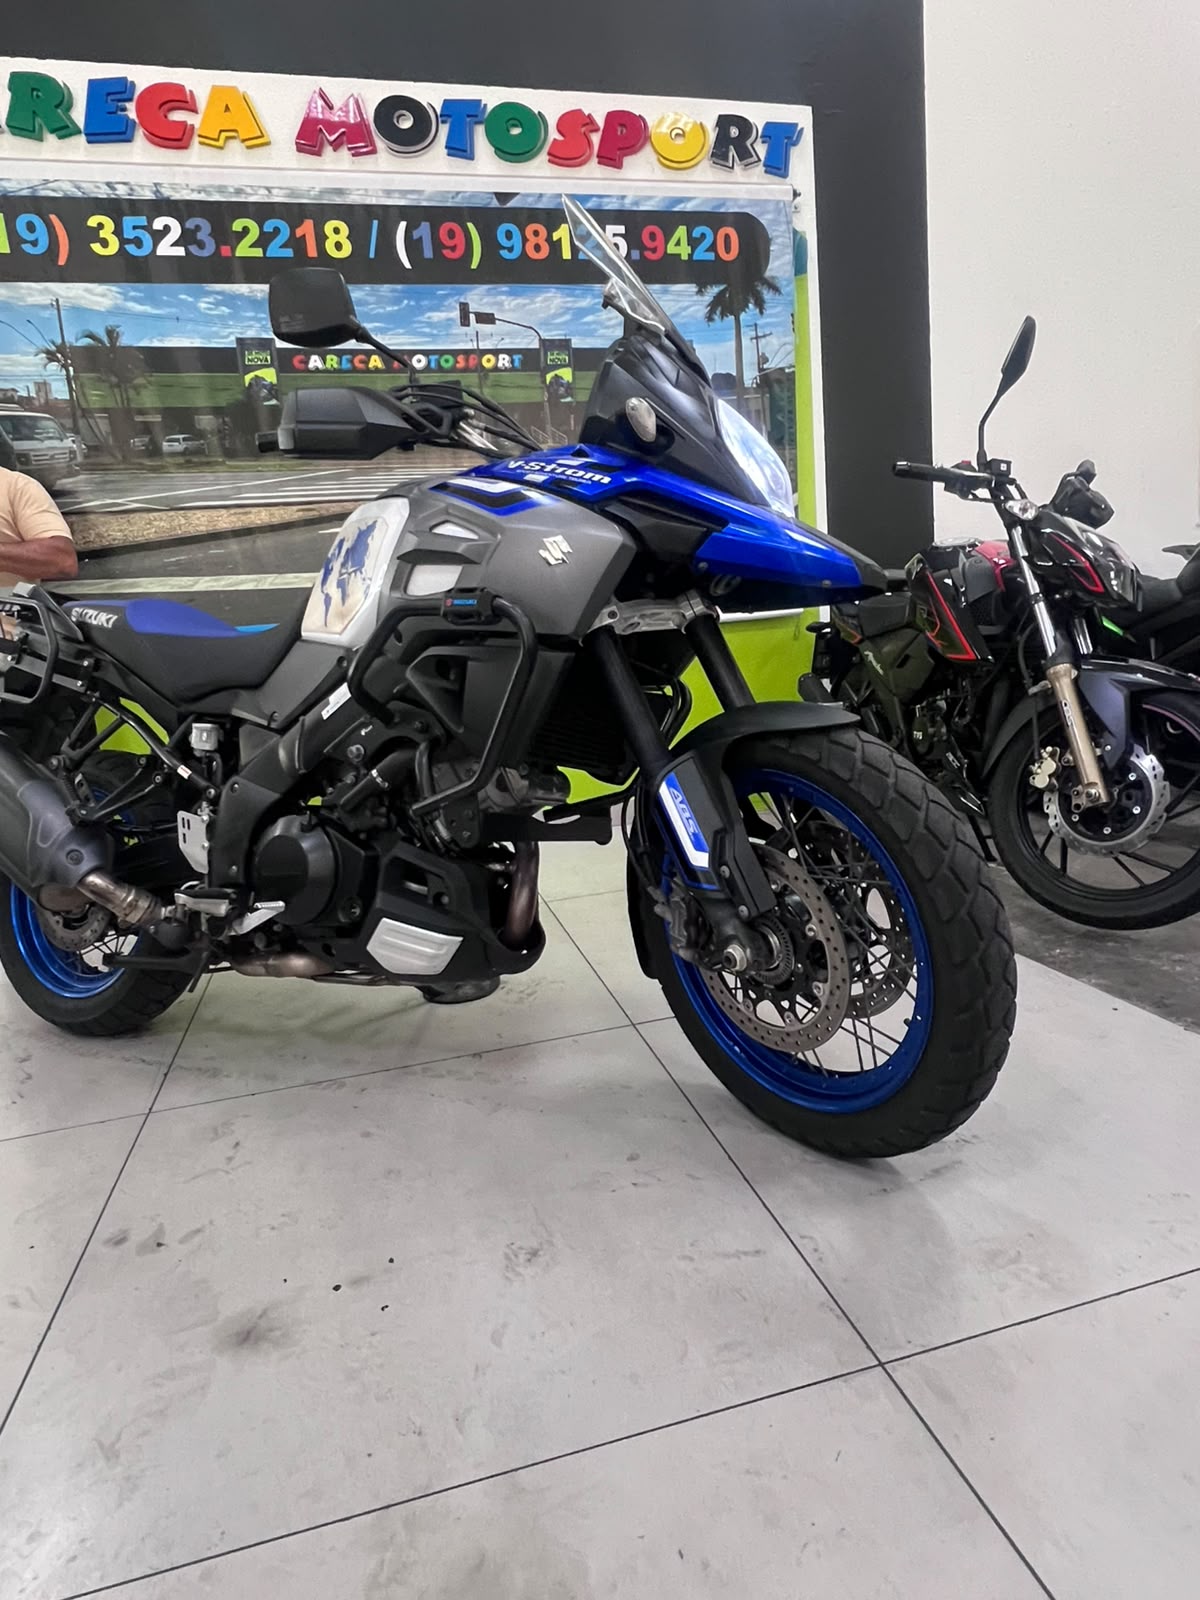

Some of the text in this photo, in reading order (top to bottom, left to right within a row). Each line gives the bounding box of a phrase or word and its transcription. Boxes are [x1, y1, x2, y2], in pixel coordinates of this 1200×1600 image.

[0, 70, 804, 178] RECA MOTOSPORT
[86, 213, 353, 259] 3523.2218
[395, 220, 482, 270] (19)
[292, 354, 385, 371] CARECA
[71, 607, 118, 629] SUZUKI
